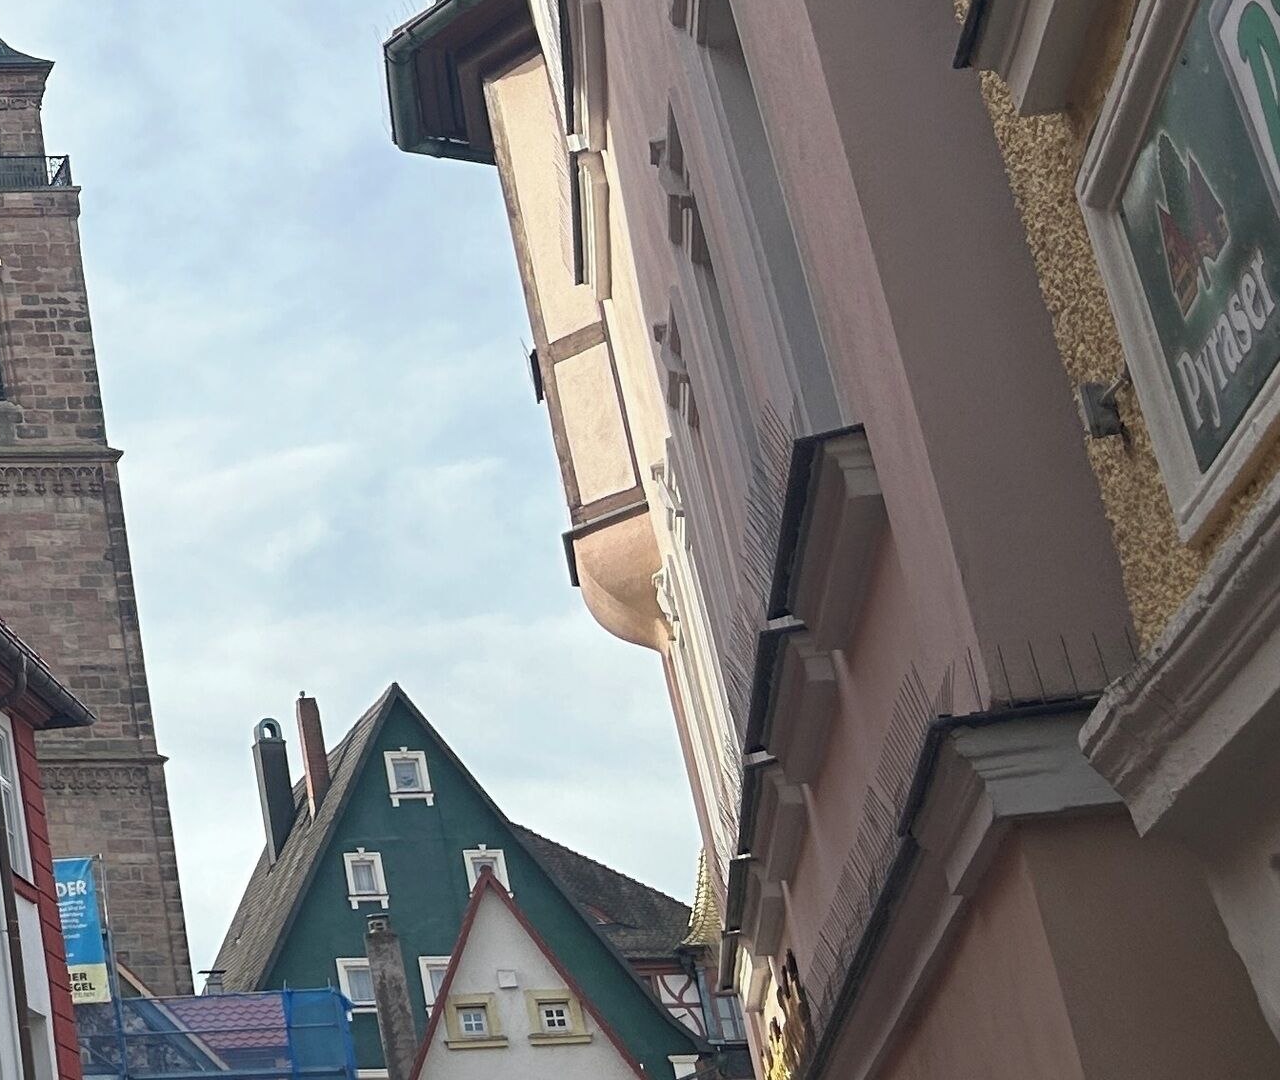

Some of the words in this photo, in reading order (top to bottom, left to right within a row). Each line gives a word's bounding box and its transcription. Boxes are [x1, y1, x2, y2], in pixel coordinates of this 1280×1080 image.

[1176, 247, 1275, 430] Pyraser
[55, 879, 87, 898] DER
[69, 972, 88, 982] ER
